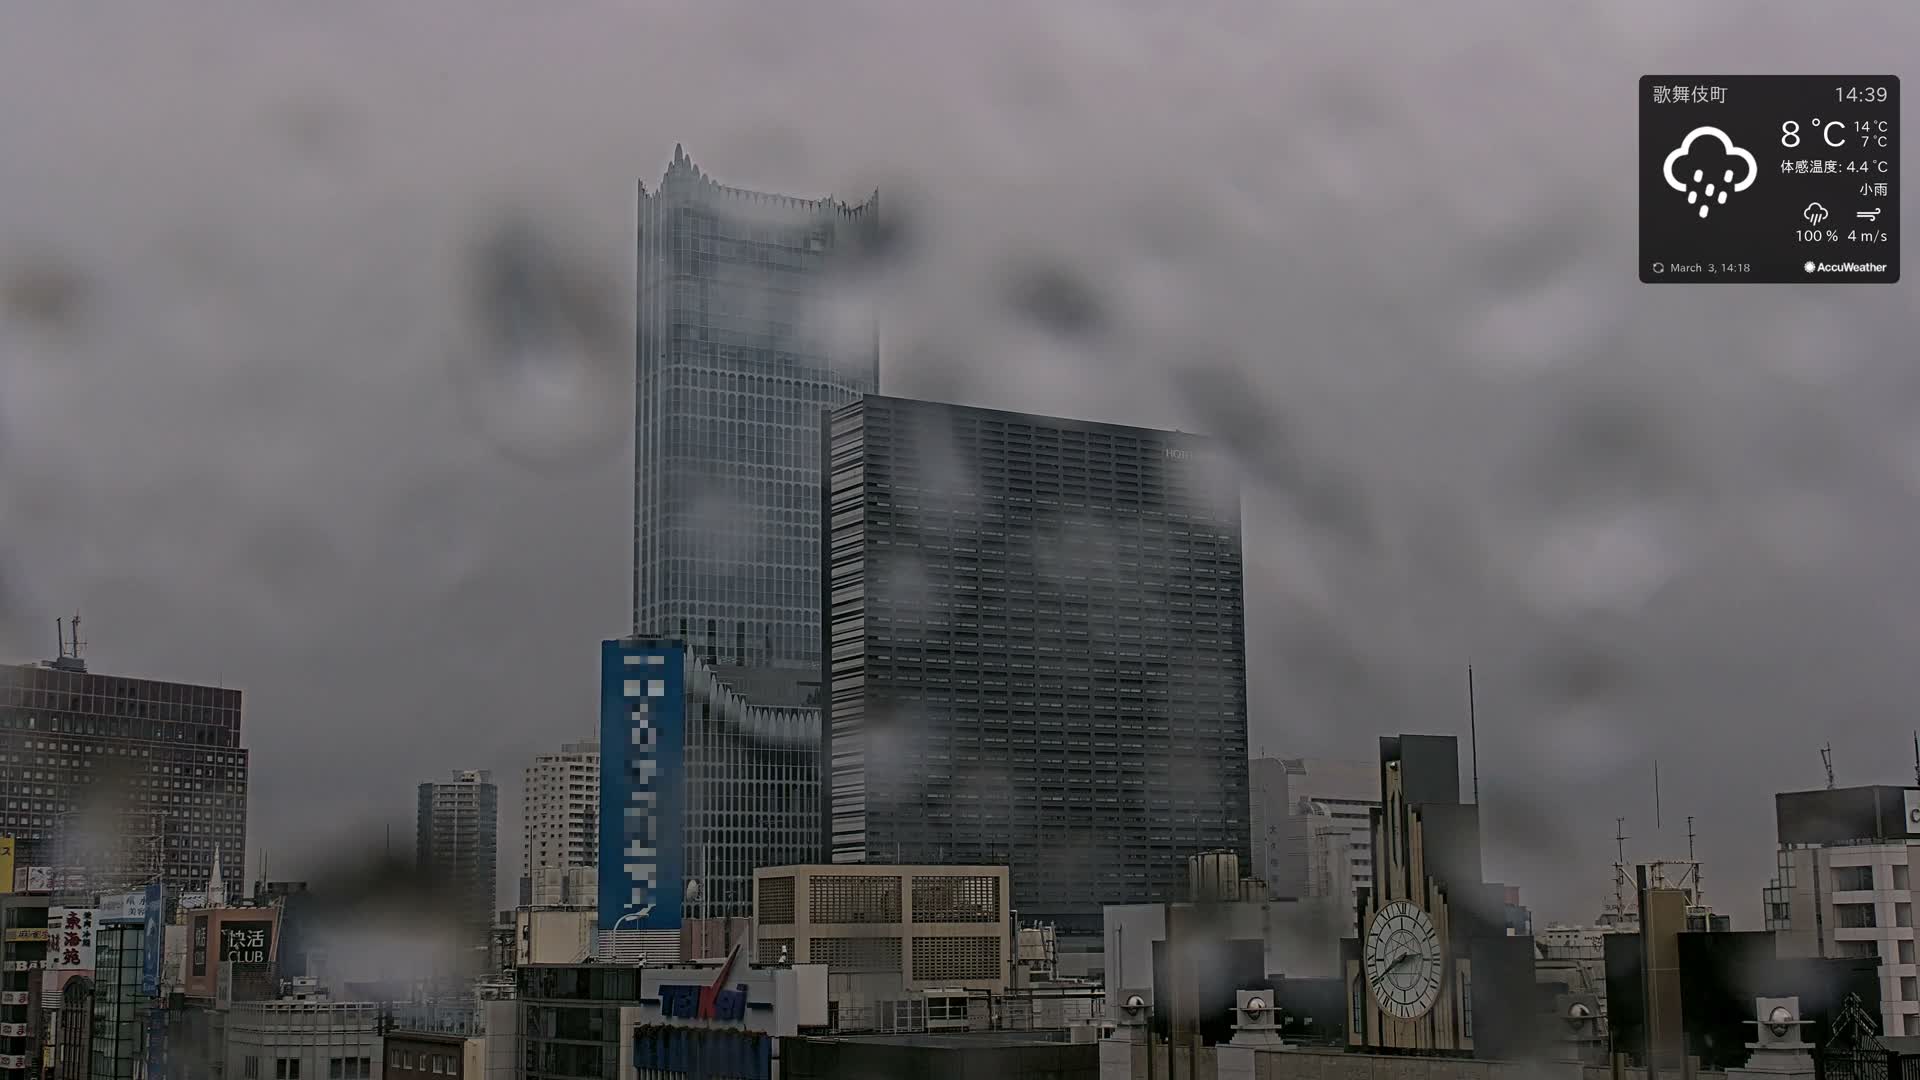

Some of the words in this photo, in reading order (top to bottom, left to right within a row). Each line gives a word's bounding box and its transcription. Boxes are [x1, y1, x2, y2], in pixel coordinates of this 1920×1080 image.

[61, 911, 82, 965] 東海苑
[229, 929, 265, 948] 快活
[228, 950, 264, 963] CLUB
